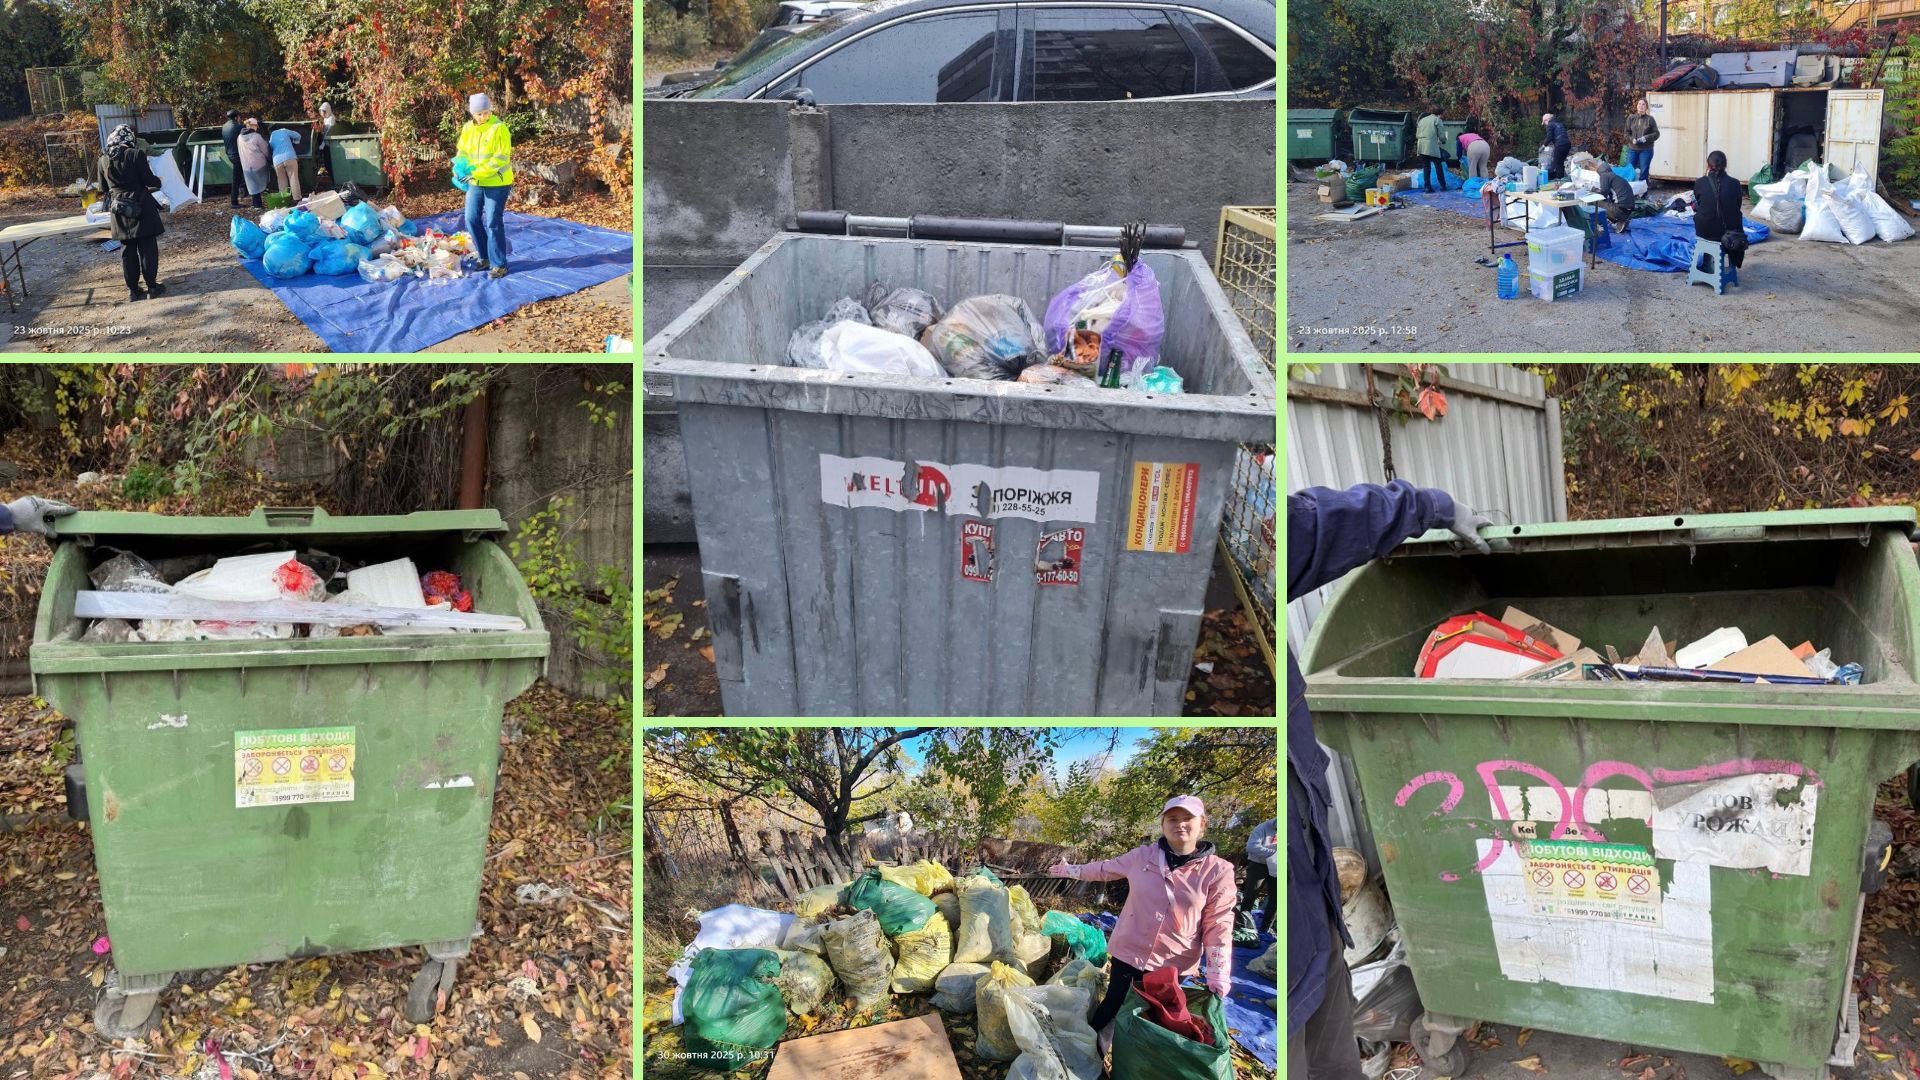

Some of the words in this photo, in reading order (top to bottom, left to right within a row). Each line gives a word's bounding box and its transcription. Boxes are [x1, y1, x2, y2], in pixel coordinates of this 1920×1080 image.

[971, 485, 1072, 506] ЗПОРІЖЖЯ
[1002, 503, 1046, 516] 228-55-25
[1134, 467, 1150, 546] КОНДИЦІОНЕРИ
[240, 733, 297, 746] ПОБУТОВІ
[300, 731, 350, 743] ВІДХОДИ
[1707, 792, 1753, 810] ТОВ
[1592, 846, 1651, 862] ВІДХОДИ
[1529, 861, 1596, 870] ЗАБОРОНЯЄТЬСЯ
[1602, 865, 1652, 876] УТИЛІЗАЦІЯ
